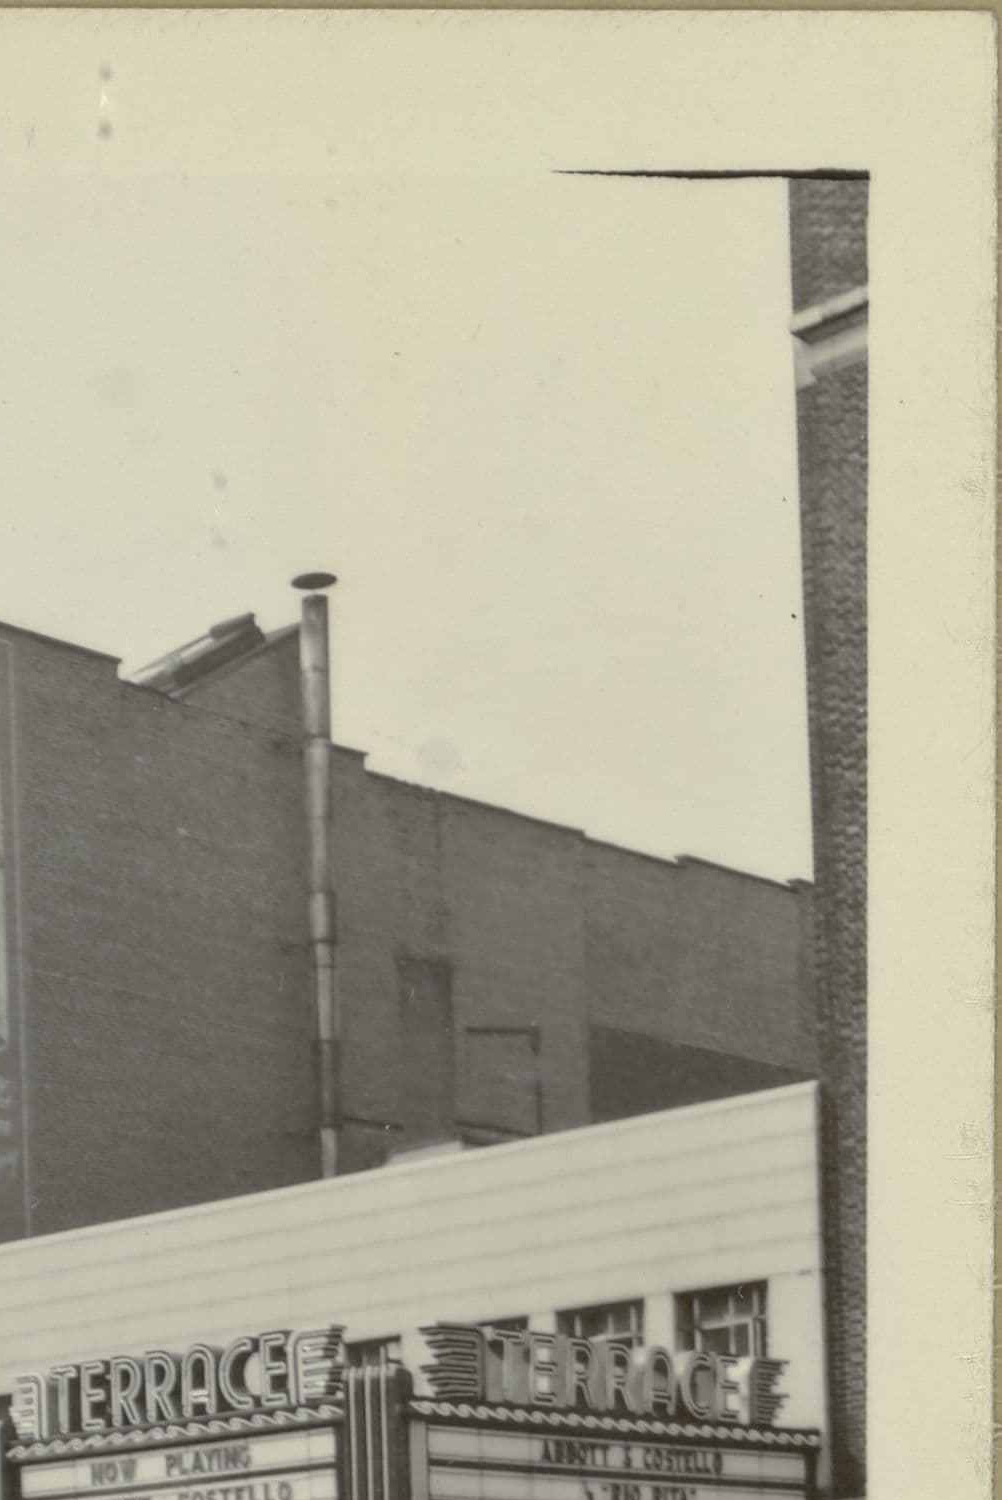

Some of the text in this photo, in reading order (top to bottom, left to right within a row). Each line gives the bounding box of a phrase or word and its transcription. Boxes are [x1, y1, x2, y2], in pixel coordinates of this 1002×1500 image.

[50, 1332, 288, 1434] TERRACE
[484, 1326, 740, 1425] TERRACE
[91, 1443, 252, 1485] NOW PLAYING
[540, 1437, 609, 1467] ABBOTT
[643, 1447, 723, 1475] COSTELLO
